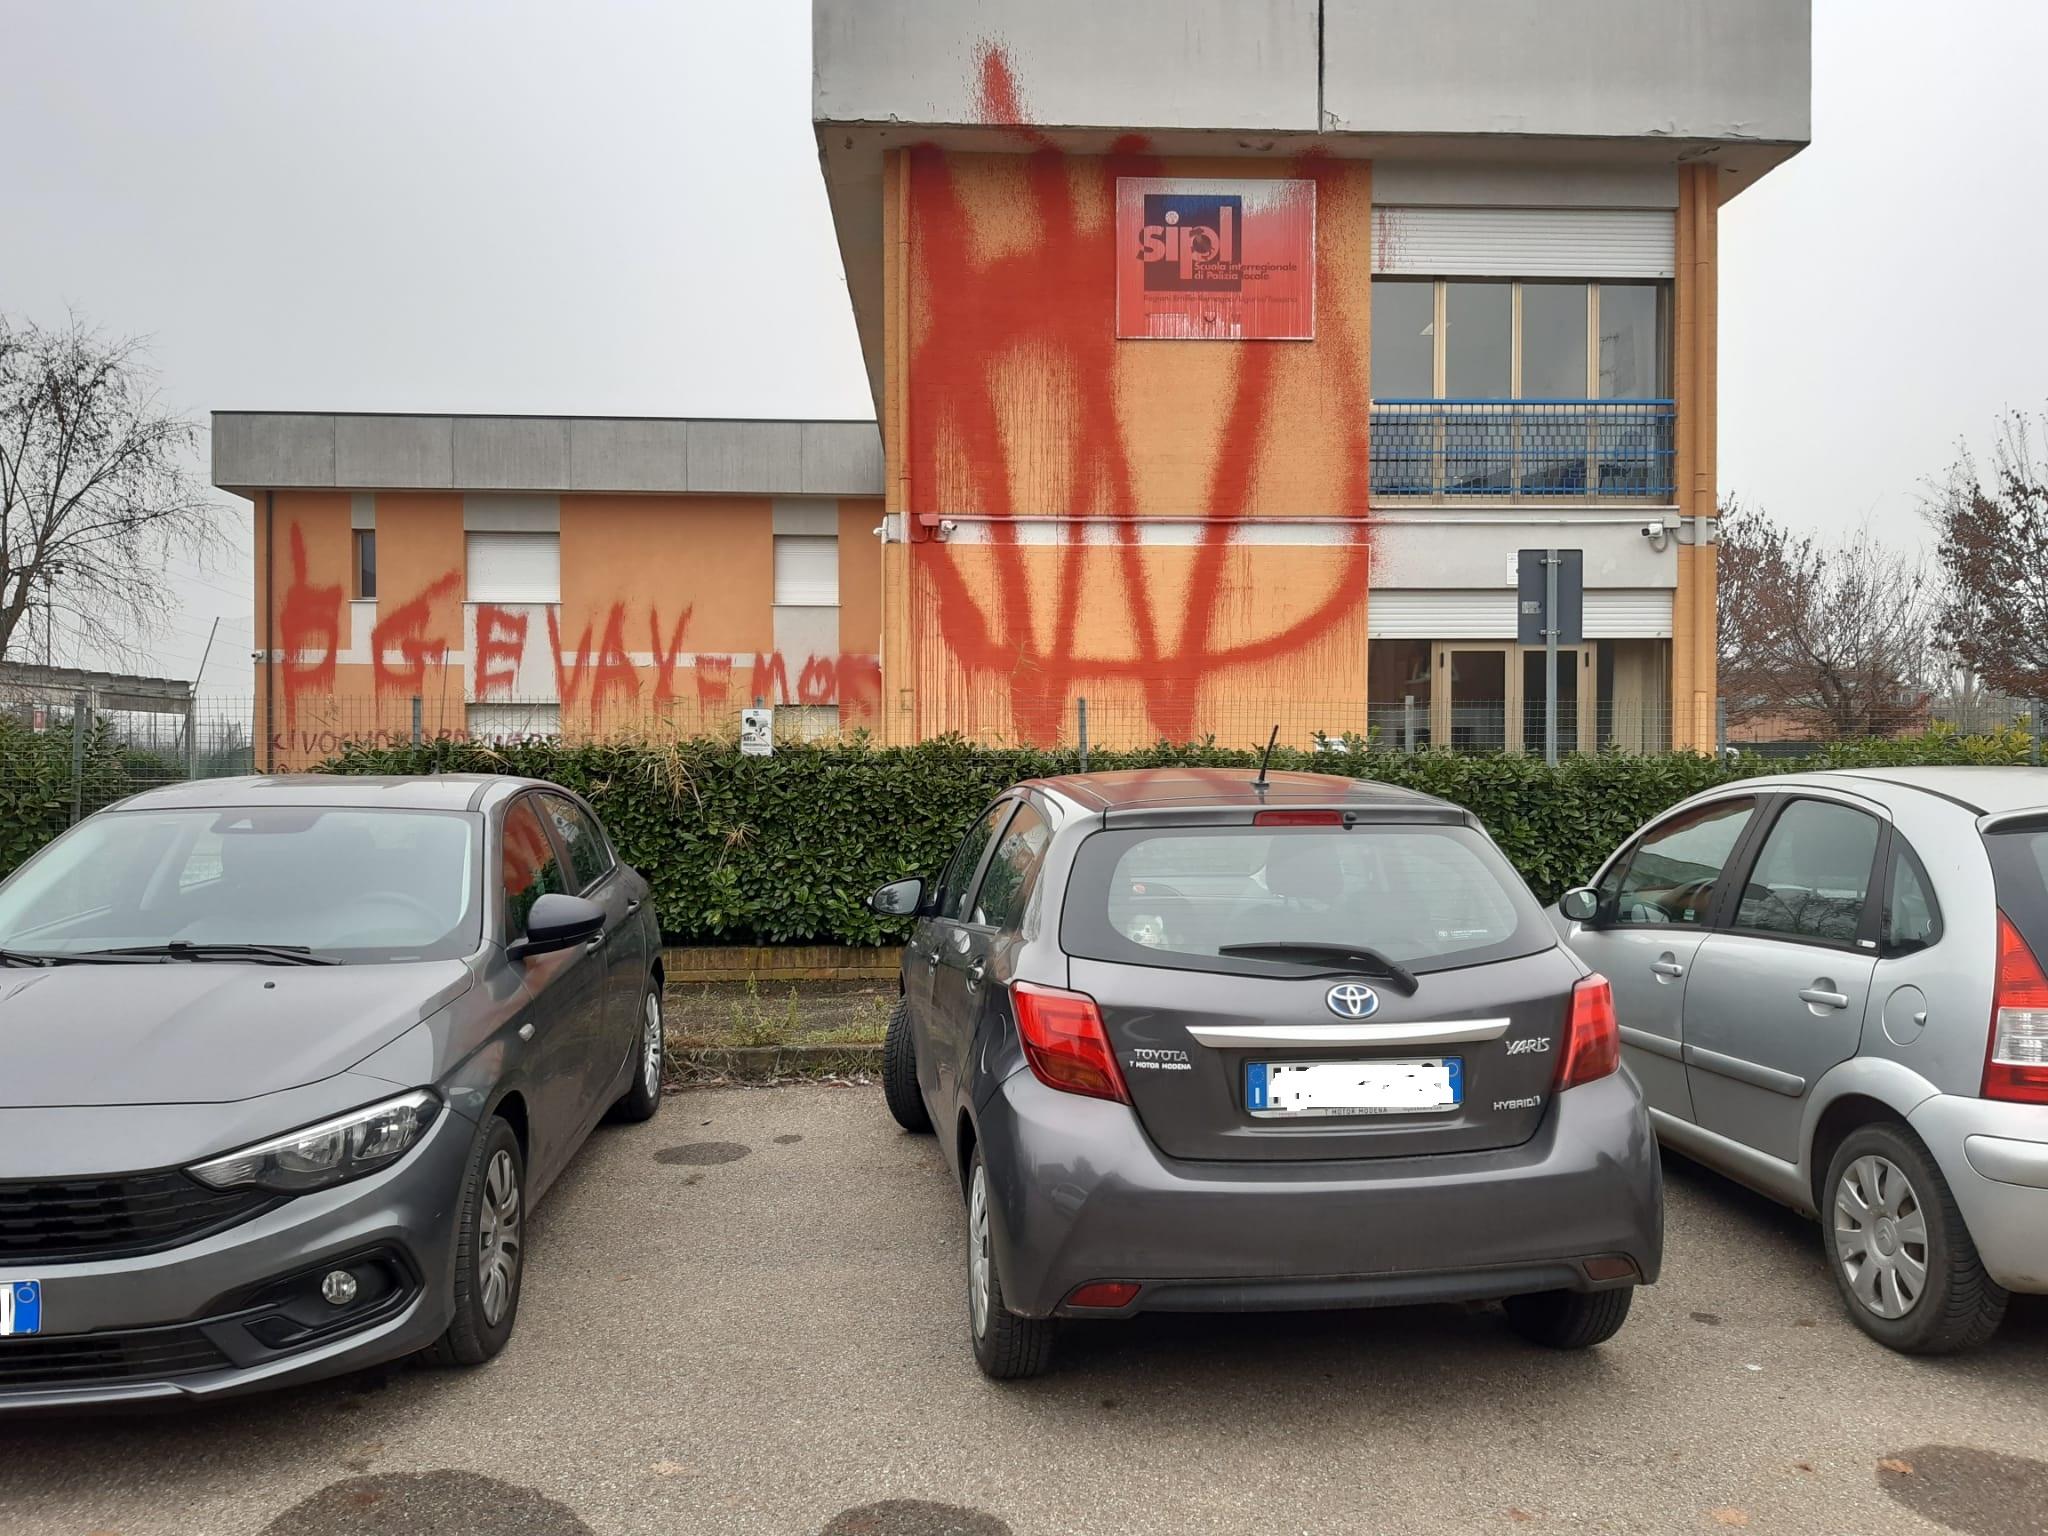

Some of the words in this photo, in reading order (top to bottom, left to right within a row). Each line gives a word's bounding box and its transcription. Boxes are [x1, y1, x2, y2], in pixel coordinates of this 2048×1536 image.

[1136, 206, 1233, 280] sipl
[1194, 261, 1226, 270] Scuola
[1229, 261, 1297, 272] interregionale
[1194, 271, 1204, 280] di
[1207, 271, 1239, 280] Polizia
[1134, 1048, 1189, 1062] TOYOTA
[1129, 1060, 1135, 1068] T
[1136, 1061, 1160, 1069] MOTOR
[1161, 1063, 1192, 1071] MODENA
[1493, 1097, 1536, 1111] HYBRID
